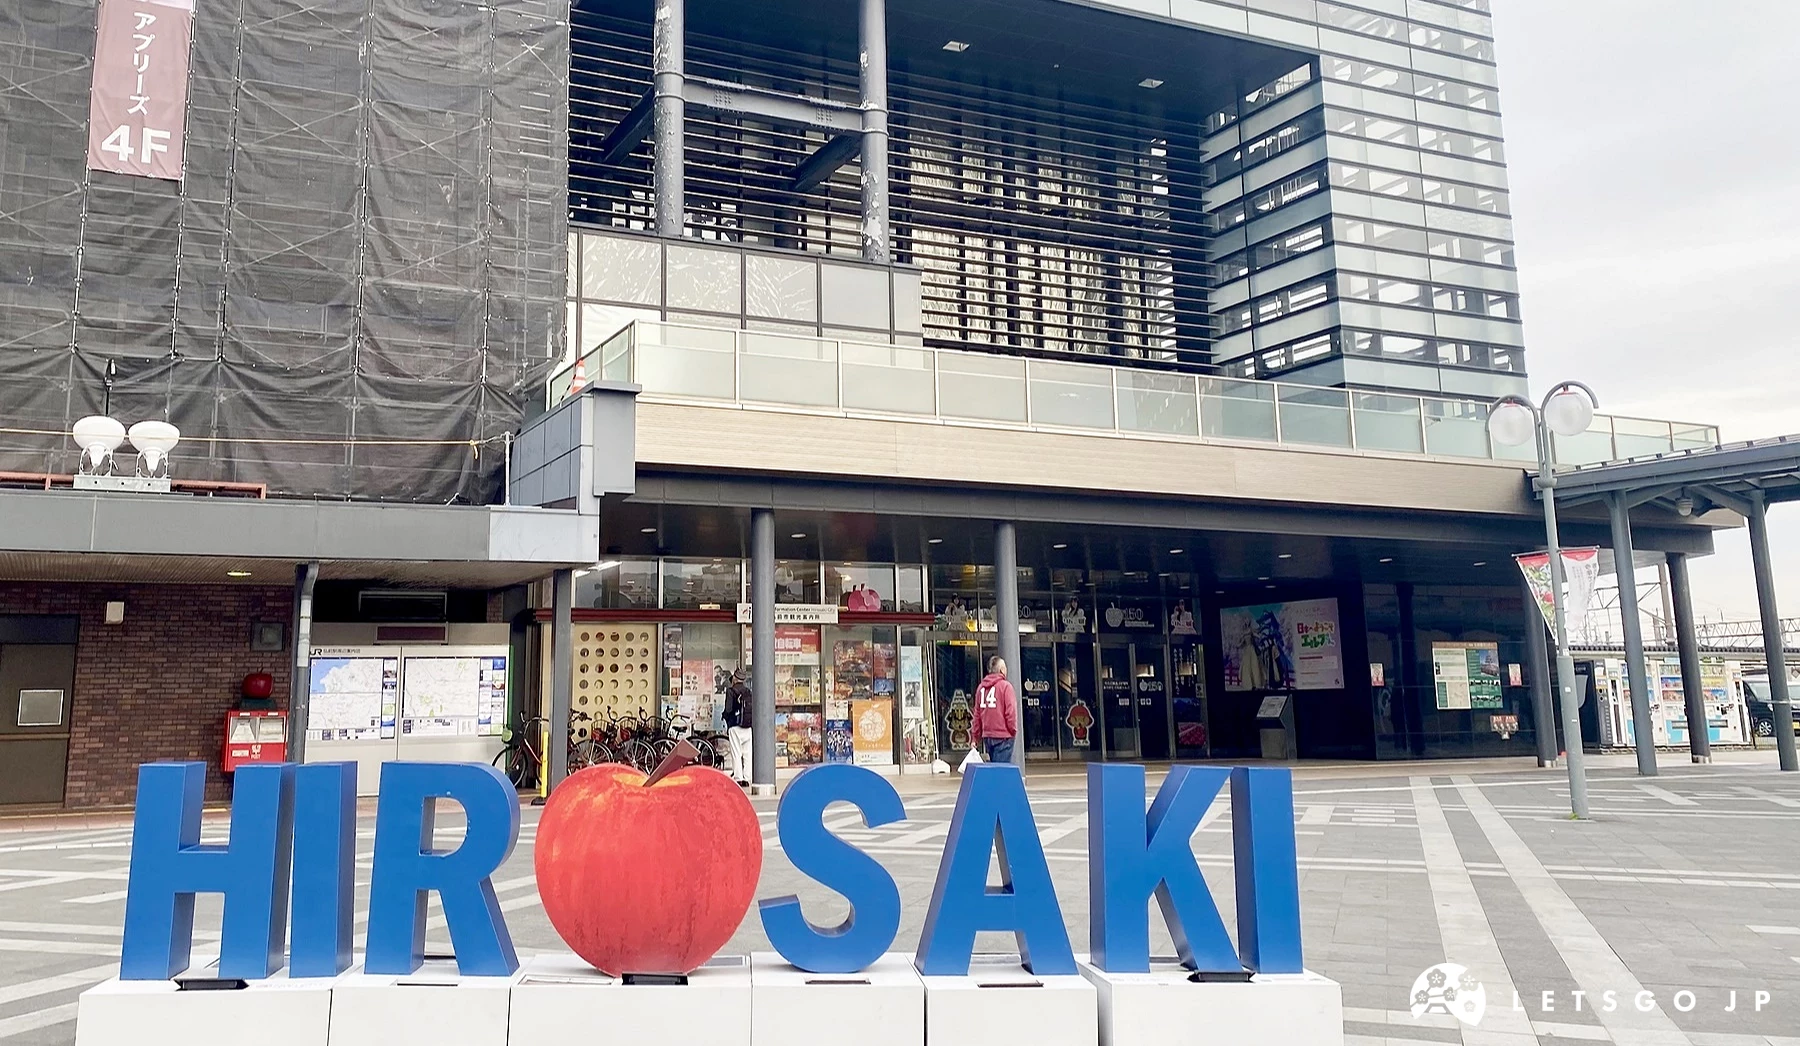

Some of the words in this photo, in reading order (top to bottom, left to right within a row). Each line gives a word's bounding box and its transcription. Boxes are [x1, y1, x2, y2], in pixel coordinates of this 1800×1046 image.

[127, 12, 157, 116] アプリーズ
[101, 124, 171, 164] 4F
[310, 648, 323, 656] JR
[980, 686, 997, 709] 14
